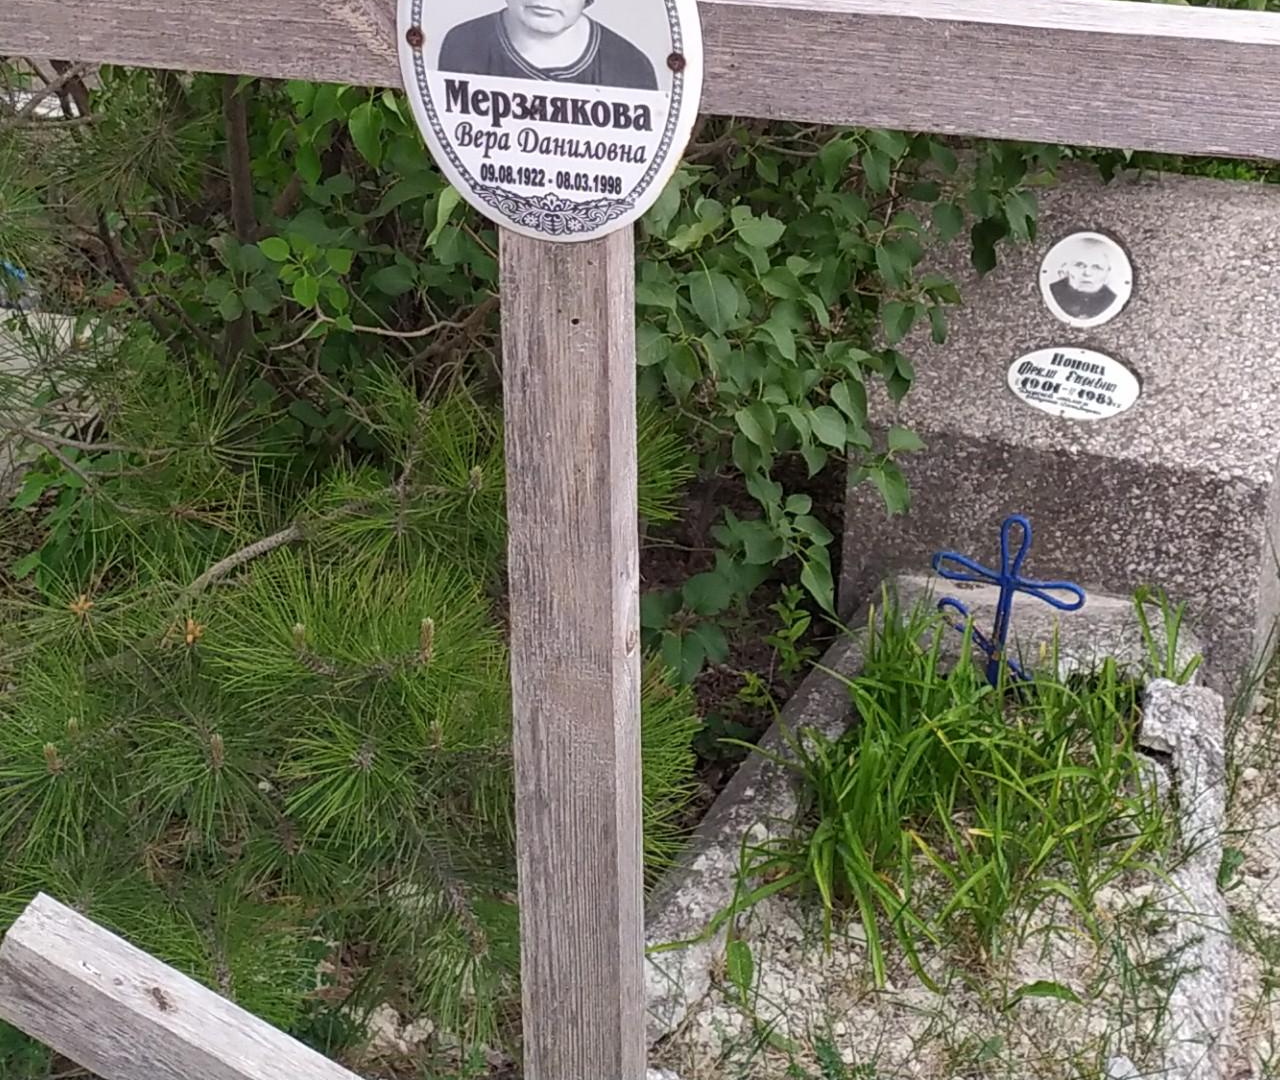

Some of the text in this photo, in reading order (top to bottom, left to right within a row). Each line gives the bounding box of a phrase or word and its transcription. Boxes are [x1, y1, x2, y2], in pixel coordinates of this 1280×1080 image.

[455, 121, 647, 164] Вера Даниловна
[480, 163, 545, 188] 09.08.1922
[556, 170, 622, 195] 08.03.1998
